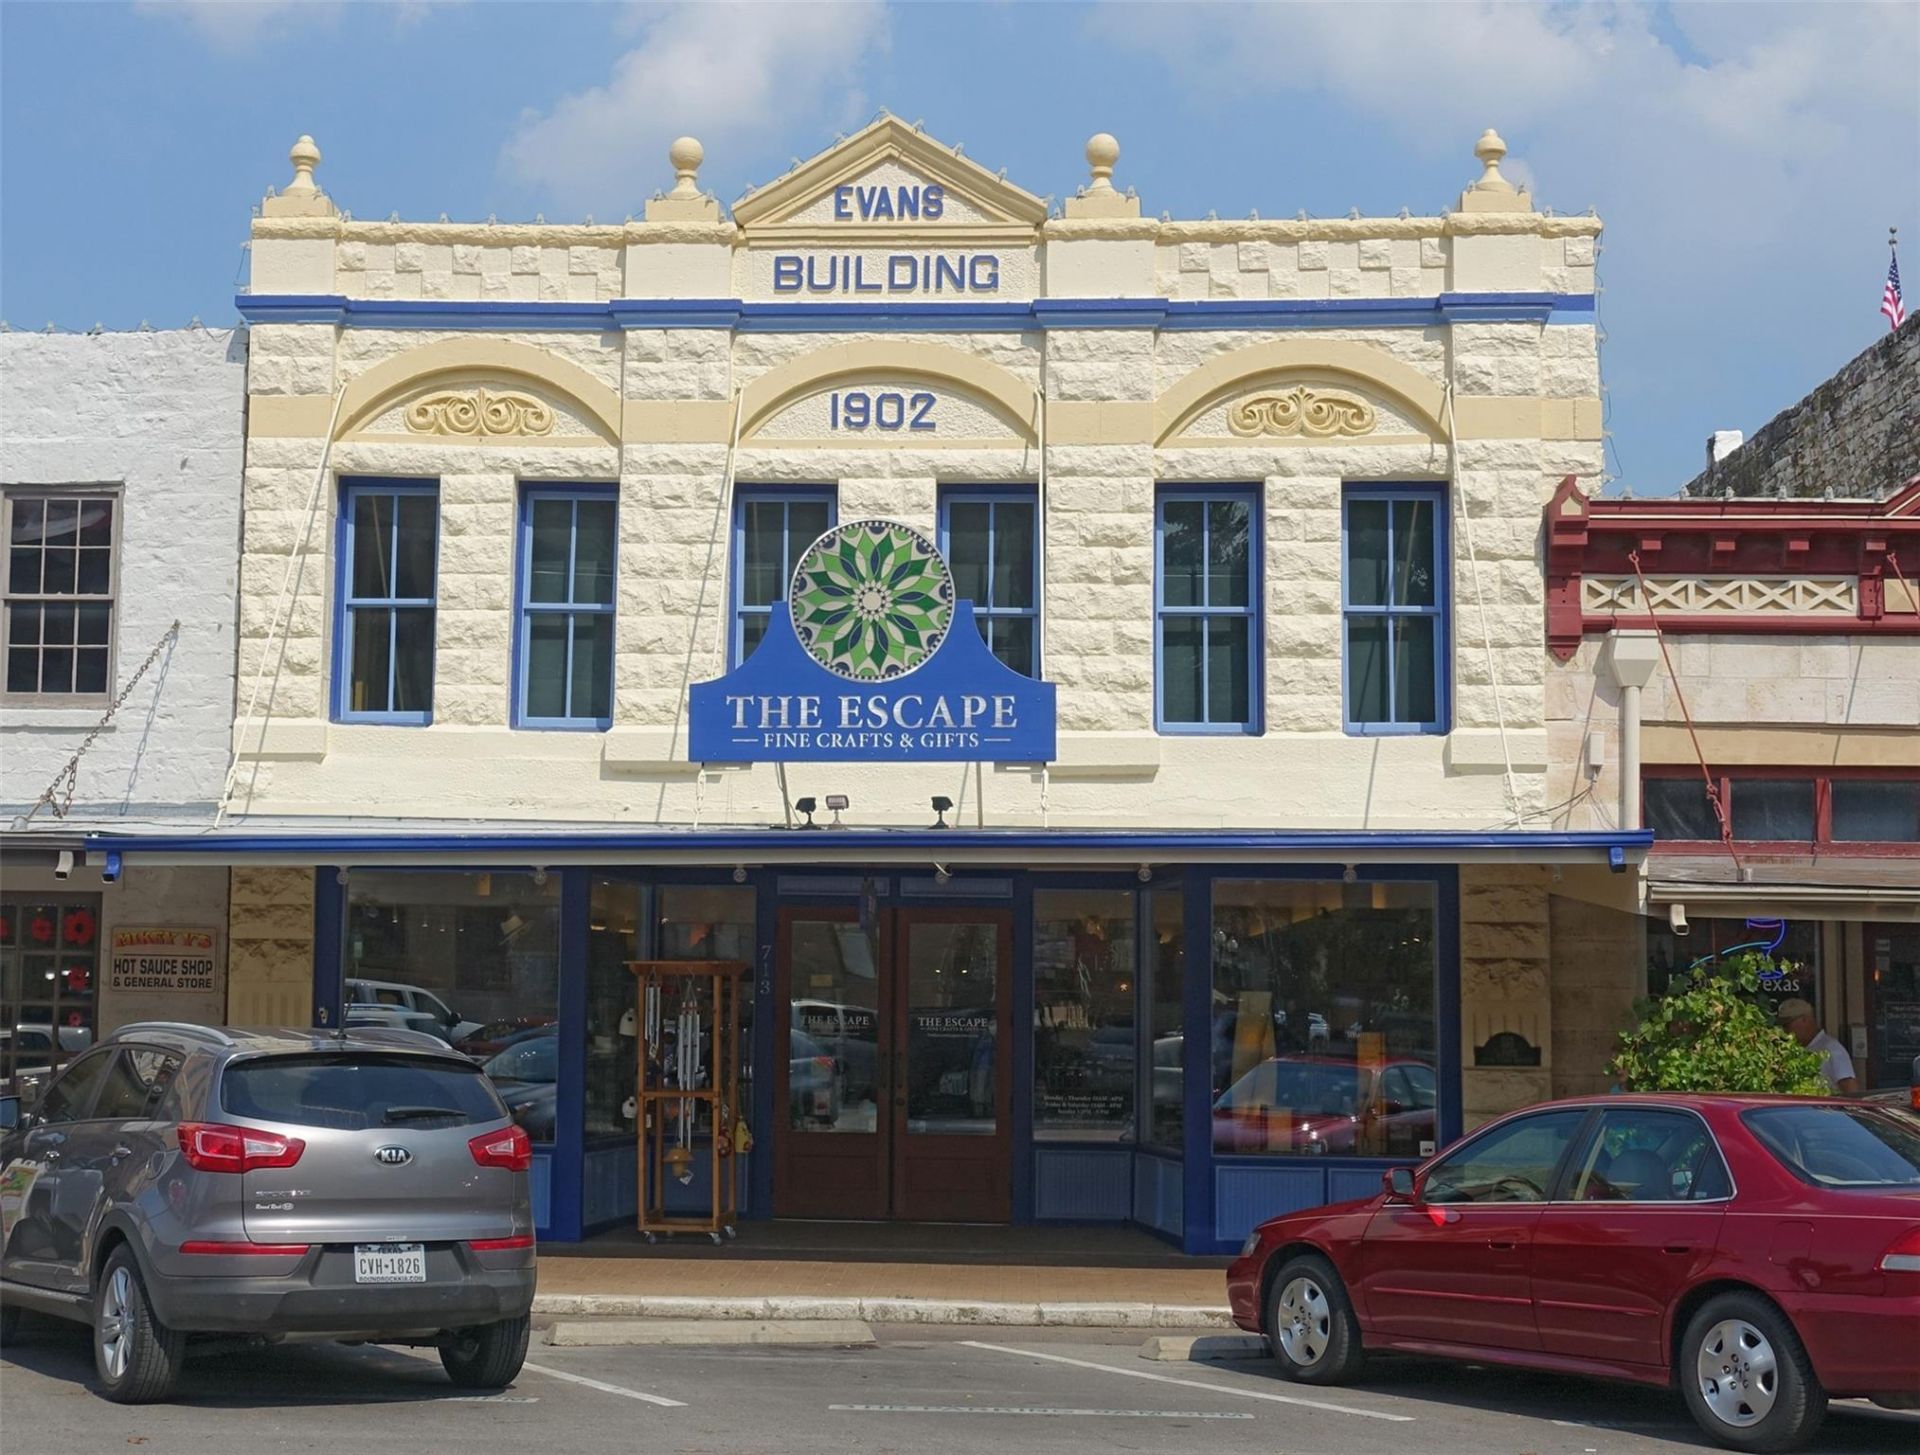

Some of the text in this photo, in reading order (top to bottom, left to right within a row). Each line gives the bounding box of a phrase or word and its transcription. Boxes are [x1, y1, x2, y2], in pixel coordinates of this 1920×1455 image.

[834, 186, 944, 219] EVANS
[773, 255, 999, 292] BUILDING
[831, 392, 936, 431] 1902
[726, 694, 1018, 729] THE ESCAPE
[763, 732, 979, 749] FINE CRAFTS & GIFTS
[113, 958, 213, 976] HOT SAUCE SHOP
[113, 977, 212, 989] & GENERAL STORE
[801, 1015, 823, 1025] THE
[918, 1016, 988, 1027] THE ESCAPE
[380, 1150, 407, 1162] KIA
